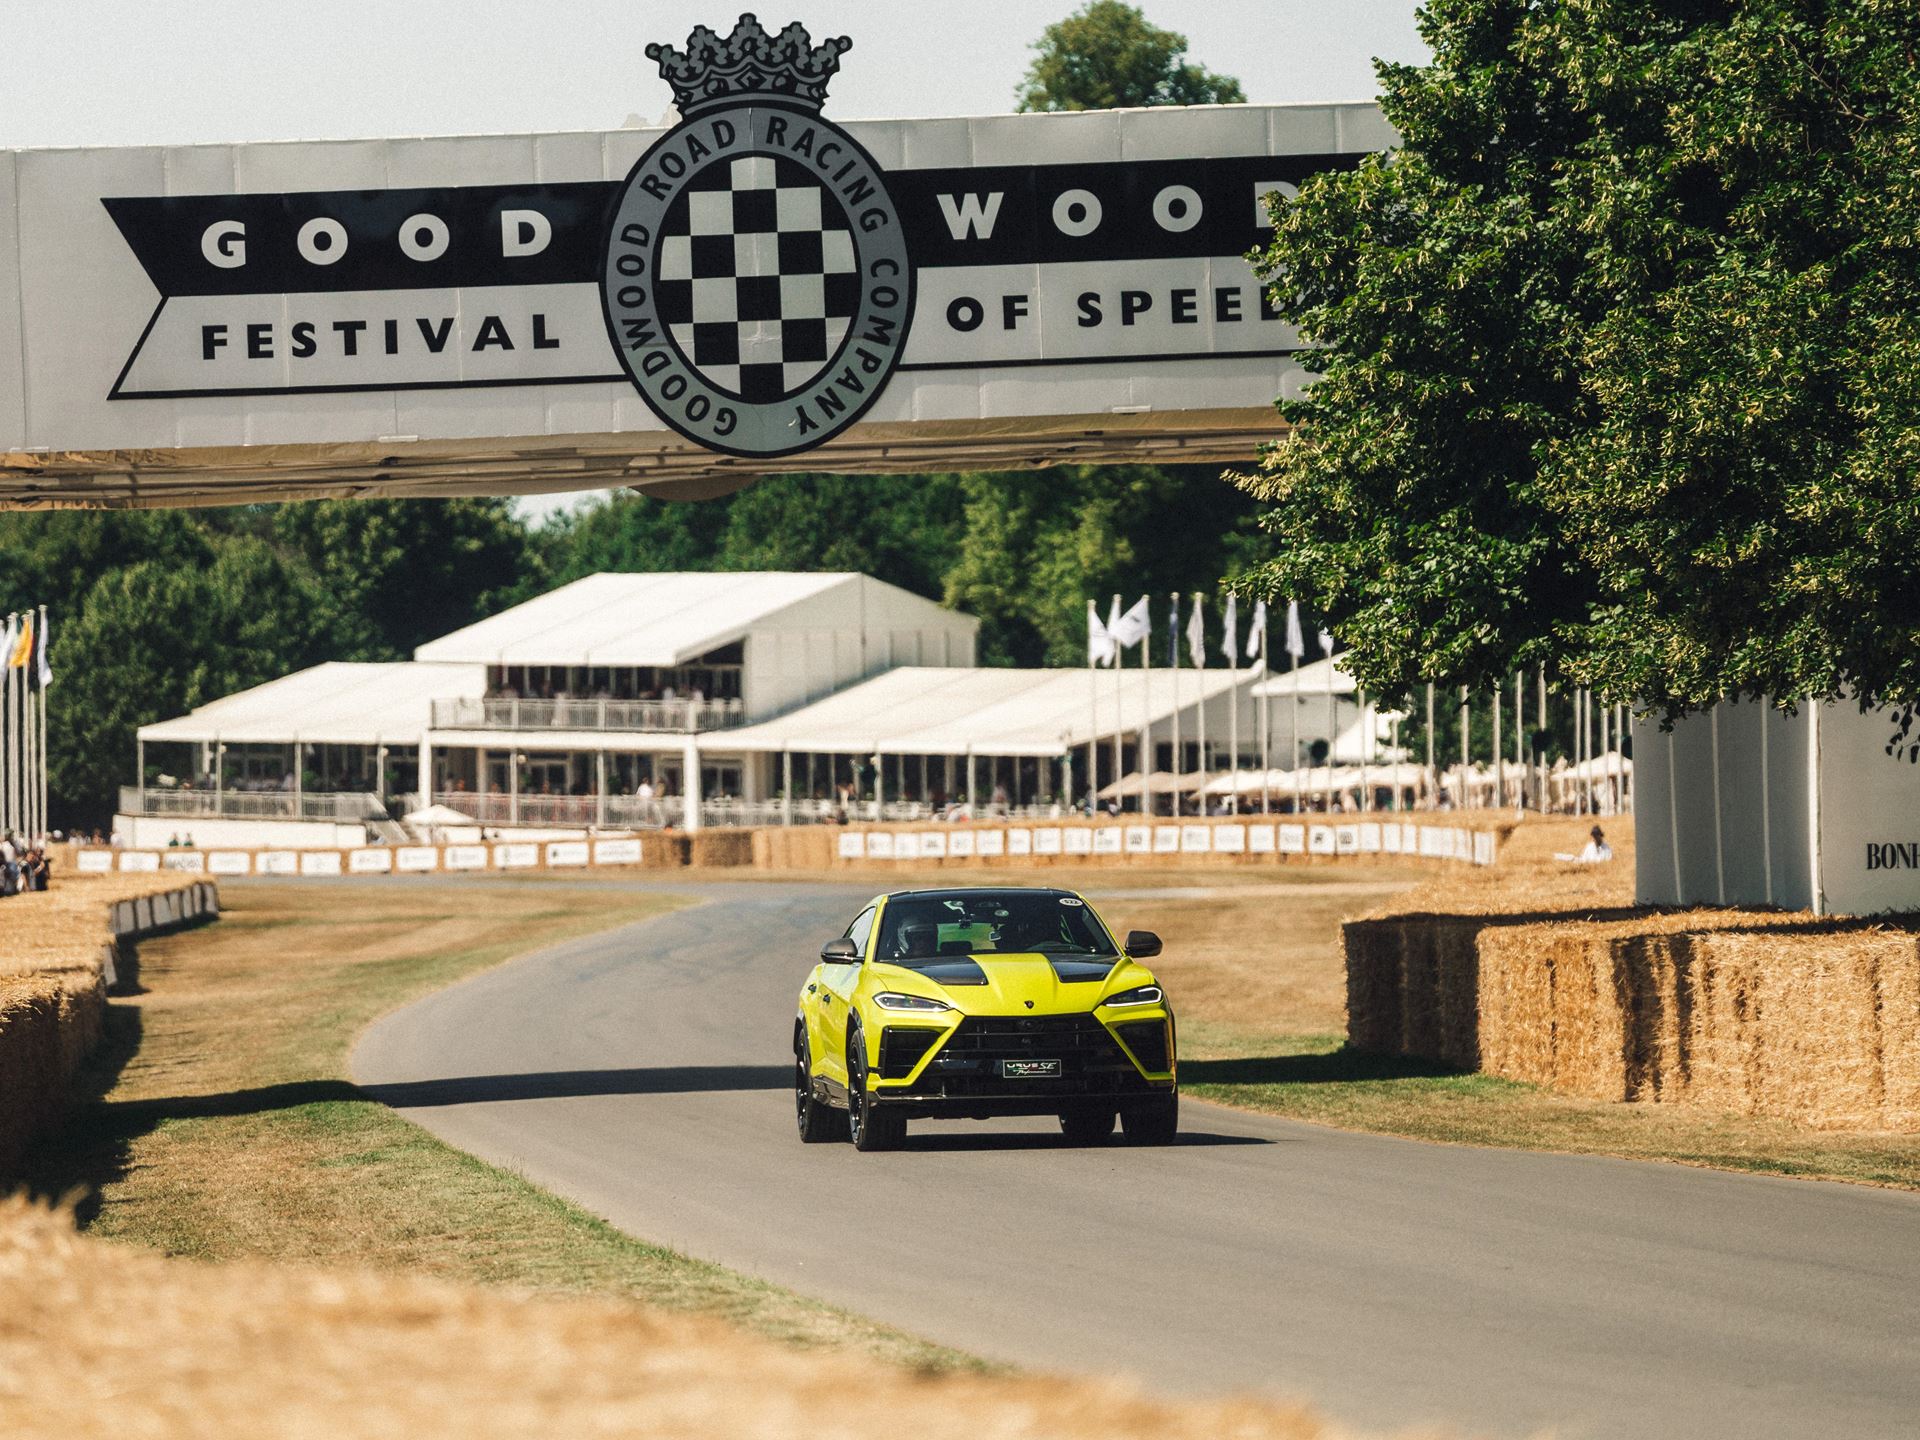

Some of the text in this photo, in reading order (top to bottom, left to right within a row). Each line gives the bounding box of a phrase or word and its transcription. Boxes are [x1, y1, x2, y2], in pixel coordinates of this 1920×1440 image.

[201, 209, 552, 269] GOOD
[616, 115, 900, 437] GOODWOOD ROAD RACING COMPANY
[201, 313, 560, 361] FESTIVAL
[946, 293, 1029, 333] OF
